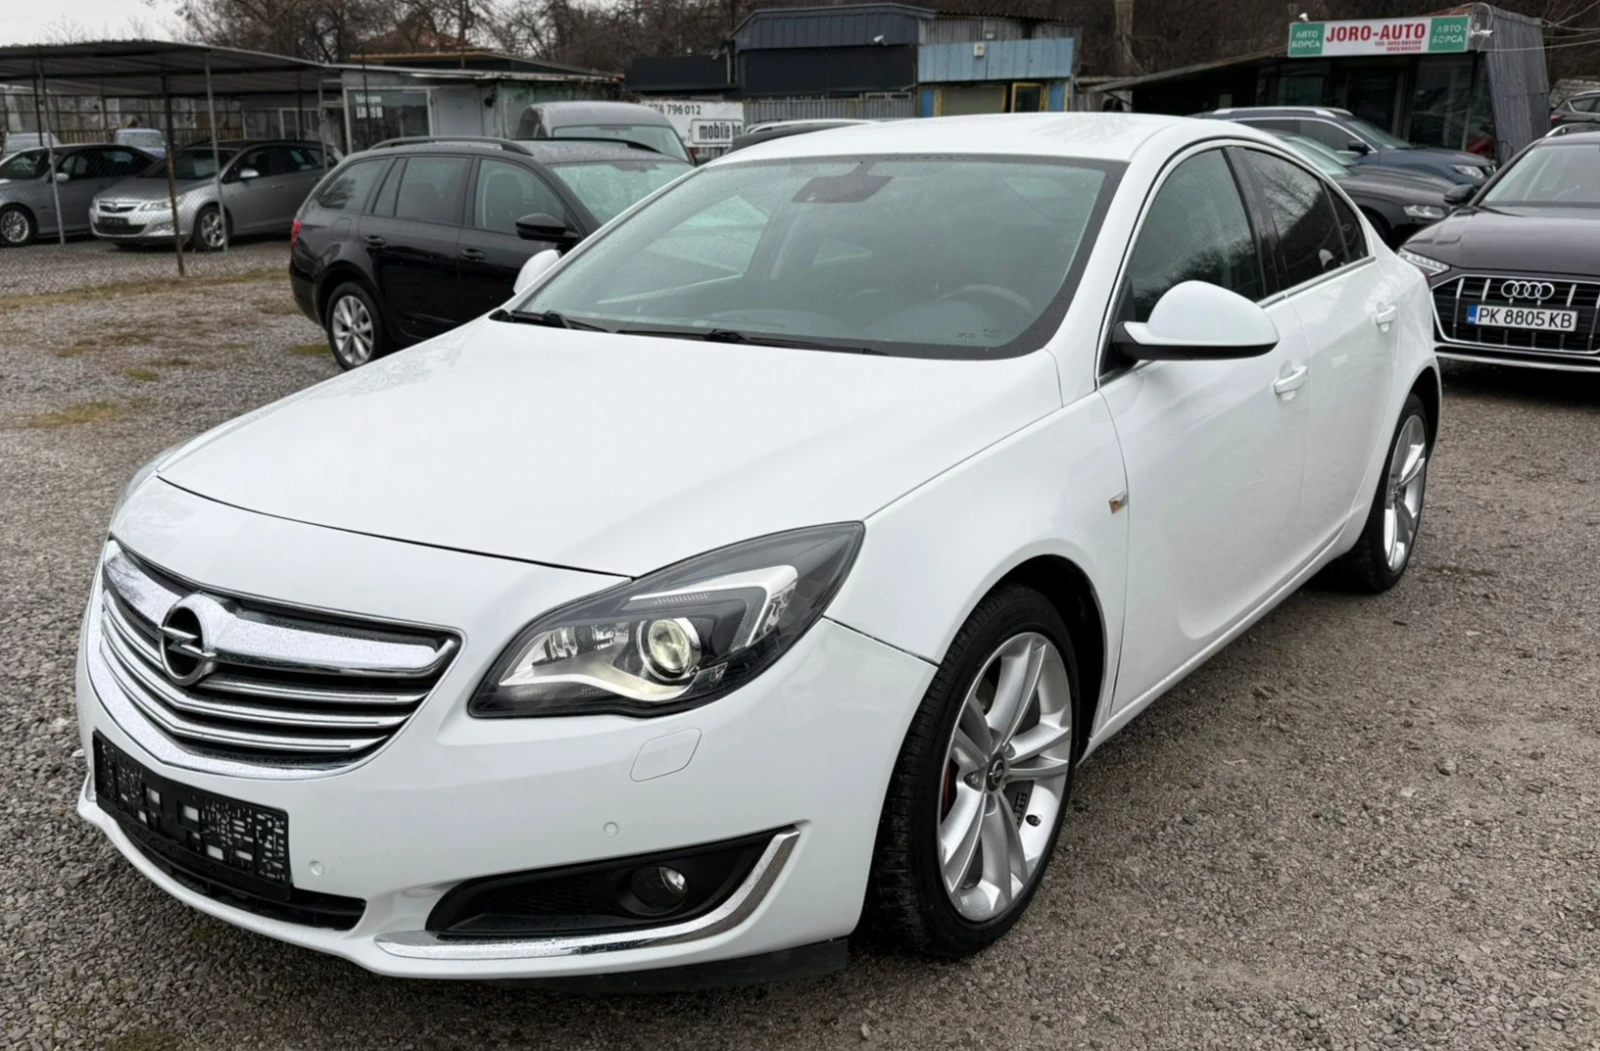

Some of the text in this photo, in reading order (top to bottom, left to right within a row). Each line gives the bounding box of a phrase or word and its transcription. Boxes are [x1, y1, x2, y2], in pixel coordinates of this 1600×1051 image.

[1295, 30, 1319, 39] АВТО
[1326, 23, 1426, 43] JORO-AUTO
[1291, 39, 1321, 49] БОРСА
[666, 104, 683, 115] 796
[684, 104, 701, 115] 012
[1478, 307, 1501, 324] PK
[1503, 309, 1546, 327] 8805
[1548, 312, 1573, 329] KB
